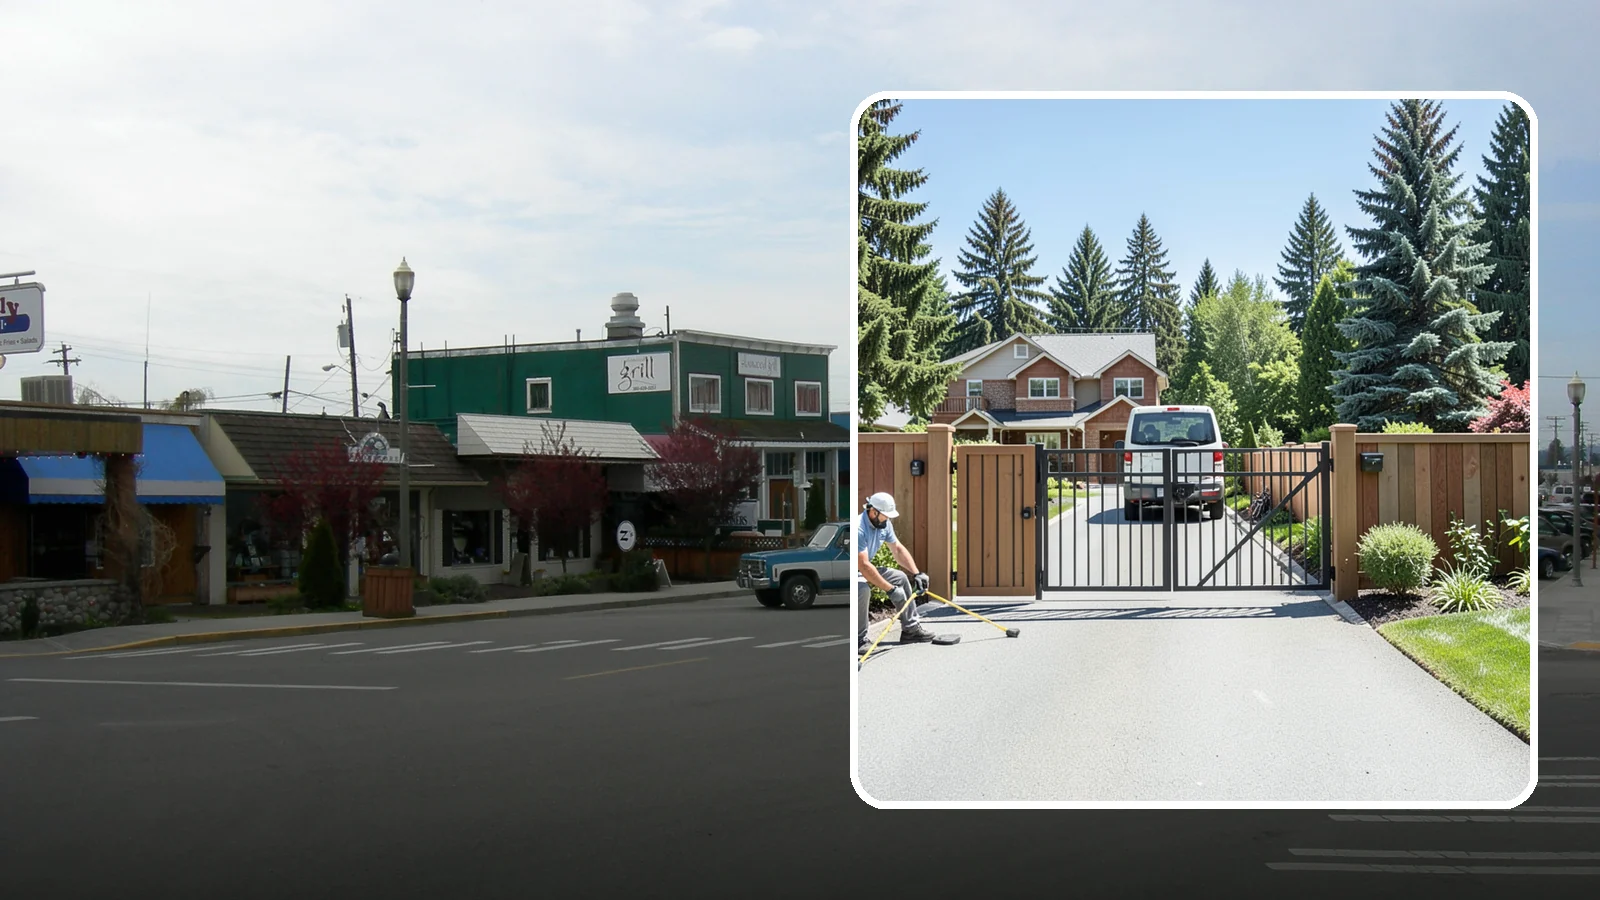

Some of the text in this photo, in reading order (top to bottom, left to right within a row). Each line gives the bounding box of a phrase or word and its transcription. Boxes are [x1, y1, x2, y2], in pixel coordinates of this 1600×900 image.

[3, 336, 38, 346] Fries Salads
[617, 356, 655, 391] grill
